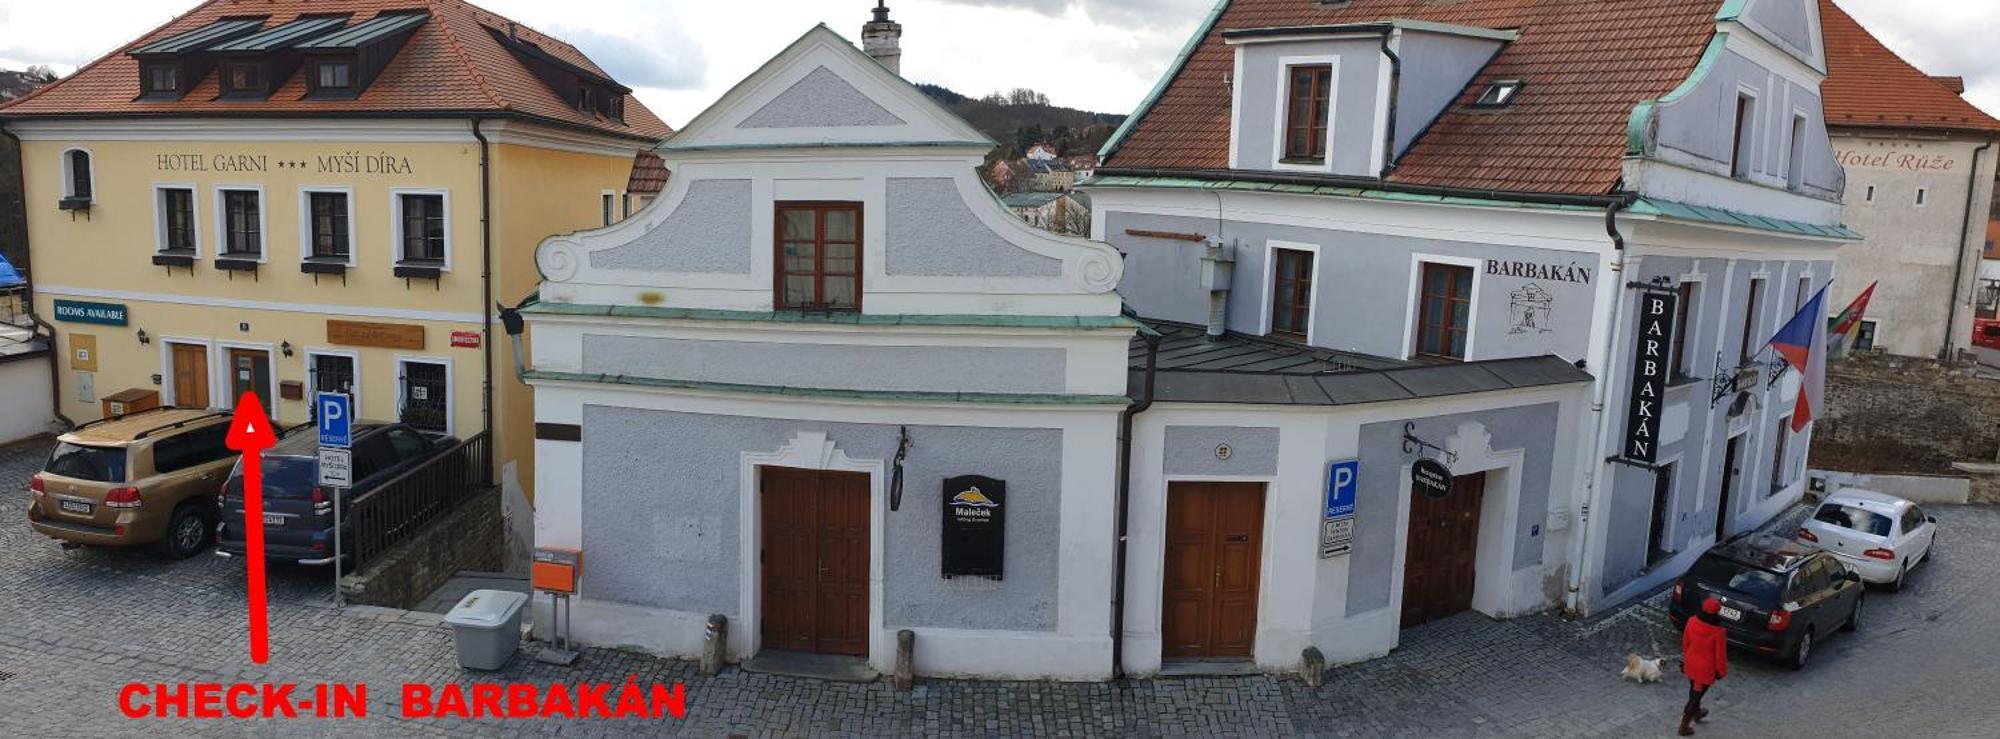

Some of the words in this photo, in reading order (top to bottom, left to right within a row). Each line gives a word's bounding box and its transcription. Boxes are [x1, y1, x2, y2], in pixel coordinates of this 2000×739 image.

[156, 154, 209, 171] HOTEL
[212, 155, 268, 172] GARNI
[317, 151, 360, 174] MYŠÍ
[366, 151, 413, 174] DÍRA
[1486, 259, 1592, 285] BARBAKÁN
[57, 306, 85, 317] ROOMS
[86, 309, 124, 320] AVAILABLE
[1633, 299, 1664, 457] BARBAKÁN
[324, 401, 342, 431] P
[1334, 467, 1353, 500] P
[955, 506, 991, 516] Maleček
